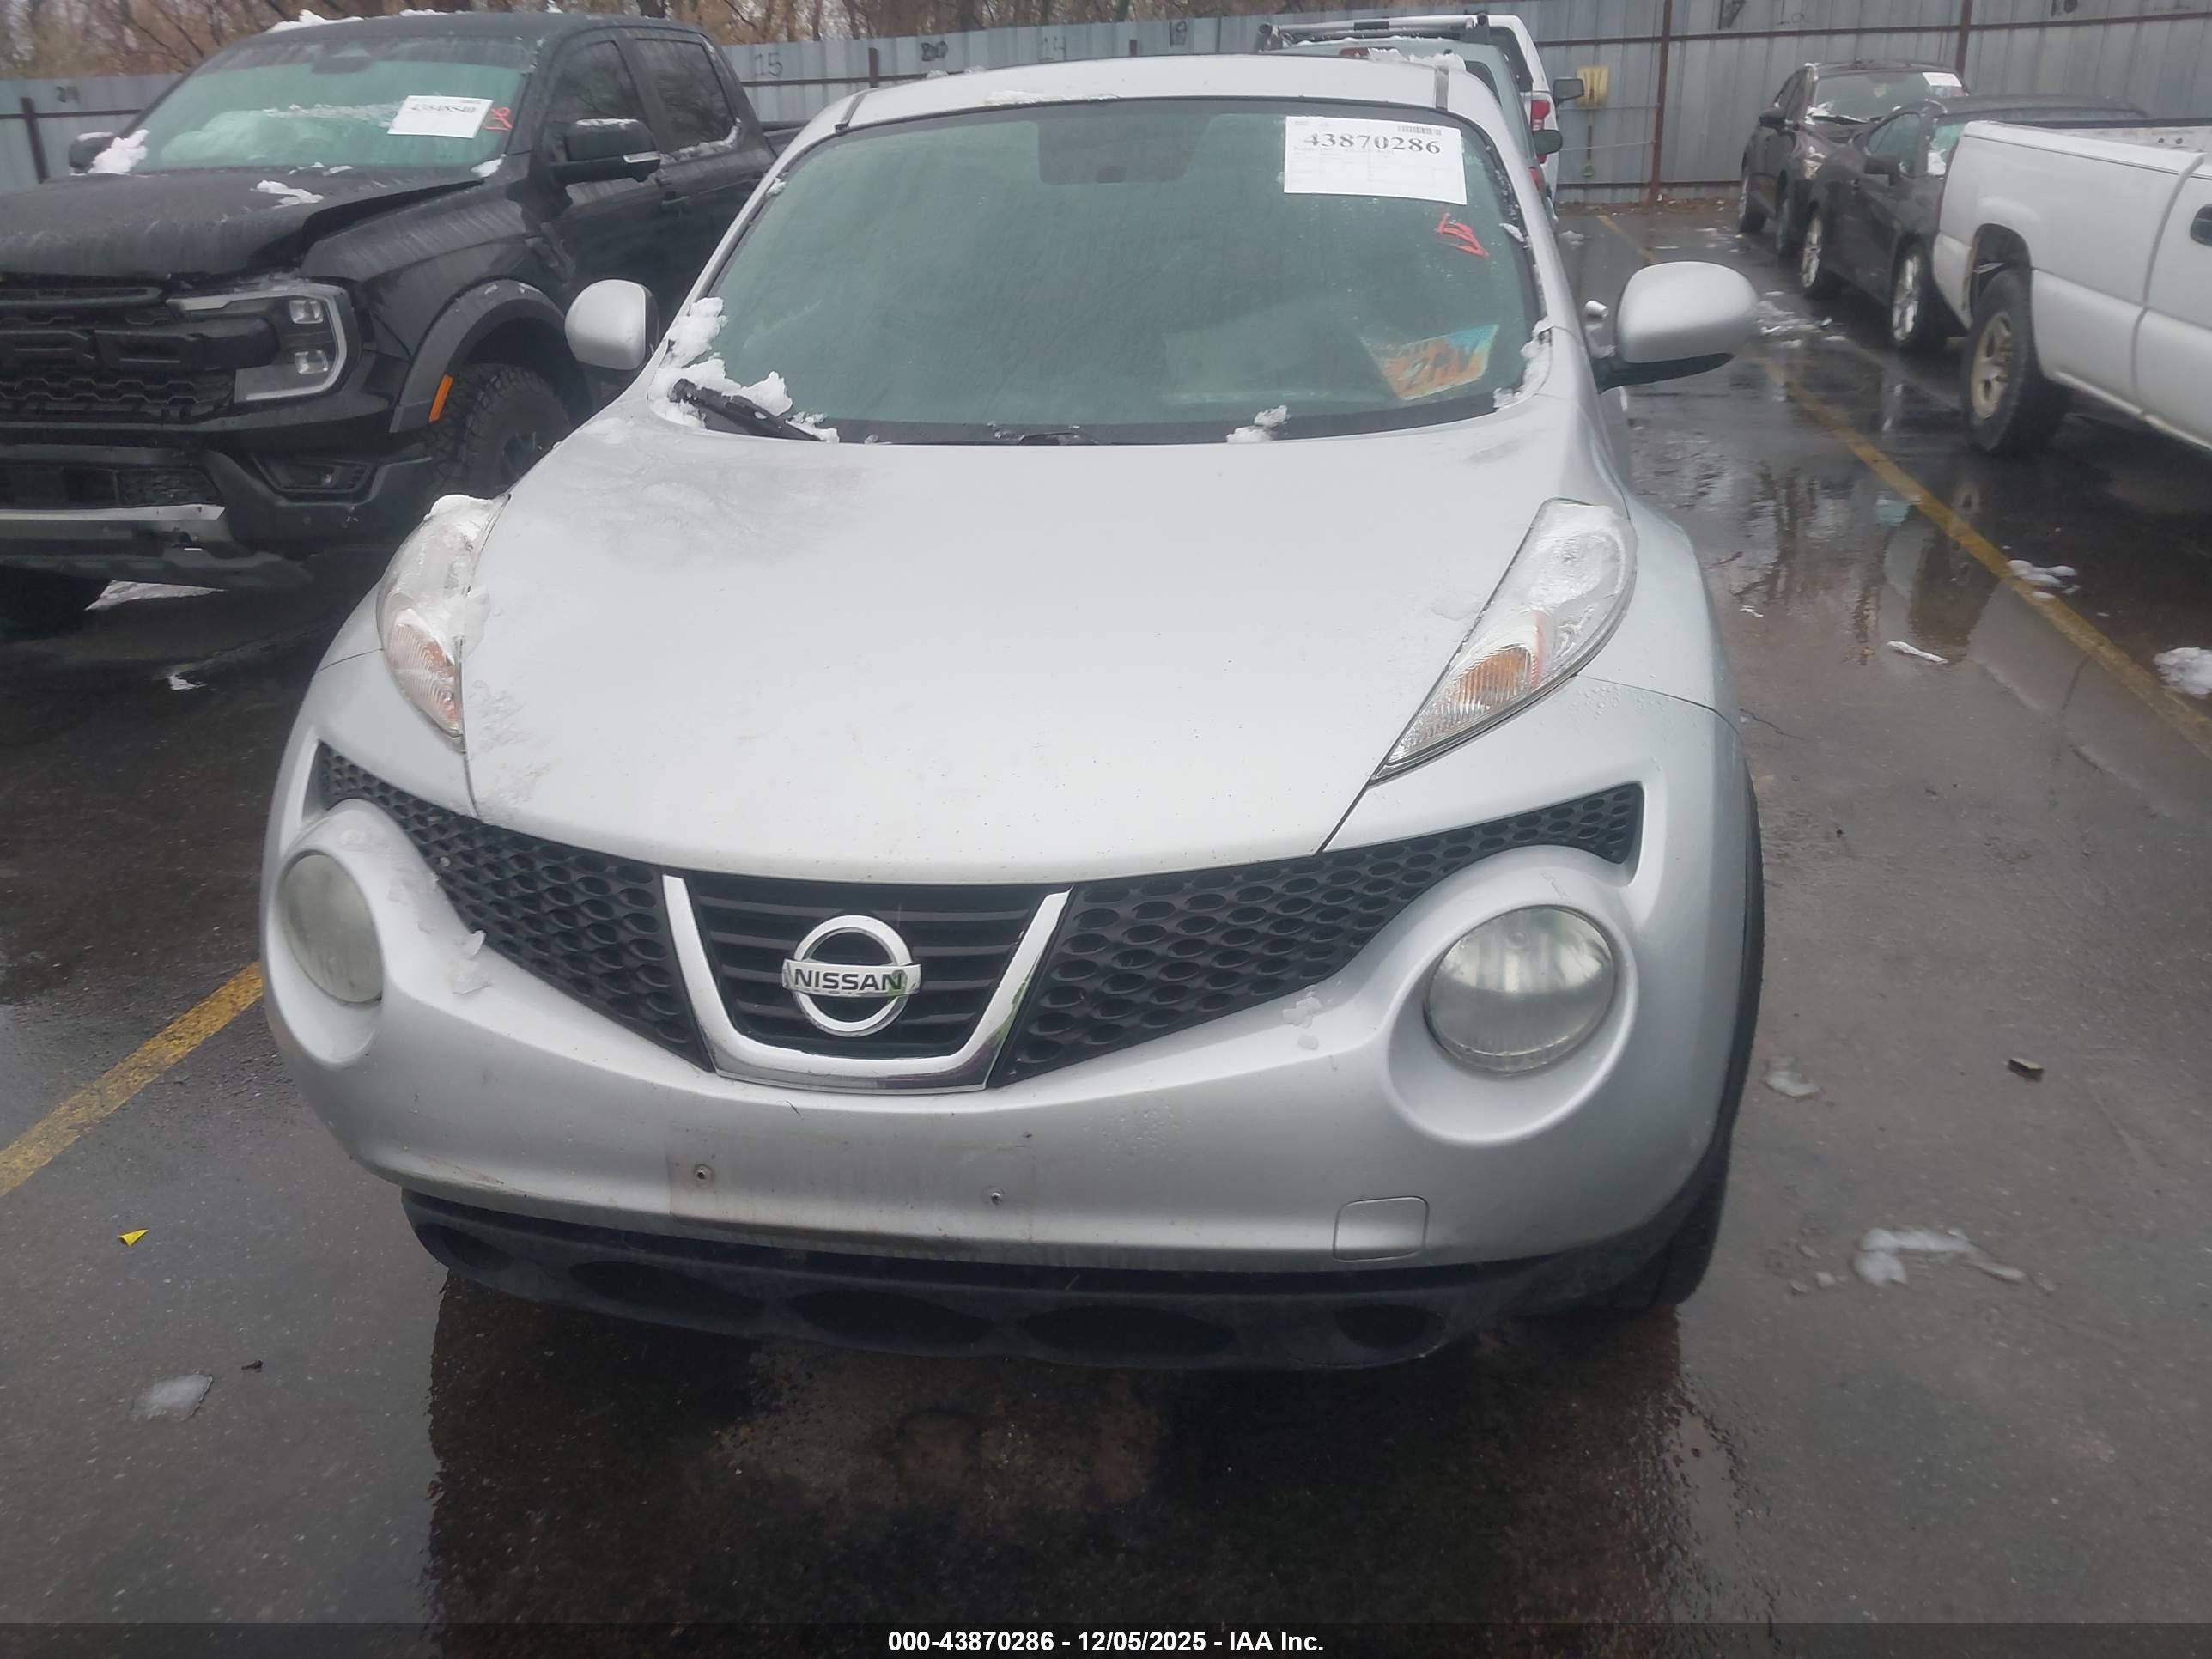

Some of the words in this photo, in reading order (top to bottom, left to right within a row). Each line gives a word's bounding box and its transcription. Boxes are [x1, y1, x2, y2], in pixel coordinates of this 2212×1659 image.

[754, 52, 783, 77] 15
[1303, 132, 1442, 155] 43870286
[793, 968, 904, 991] NISSAN
